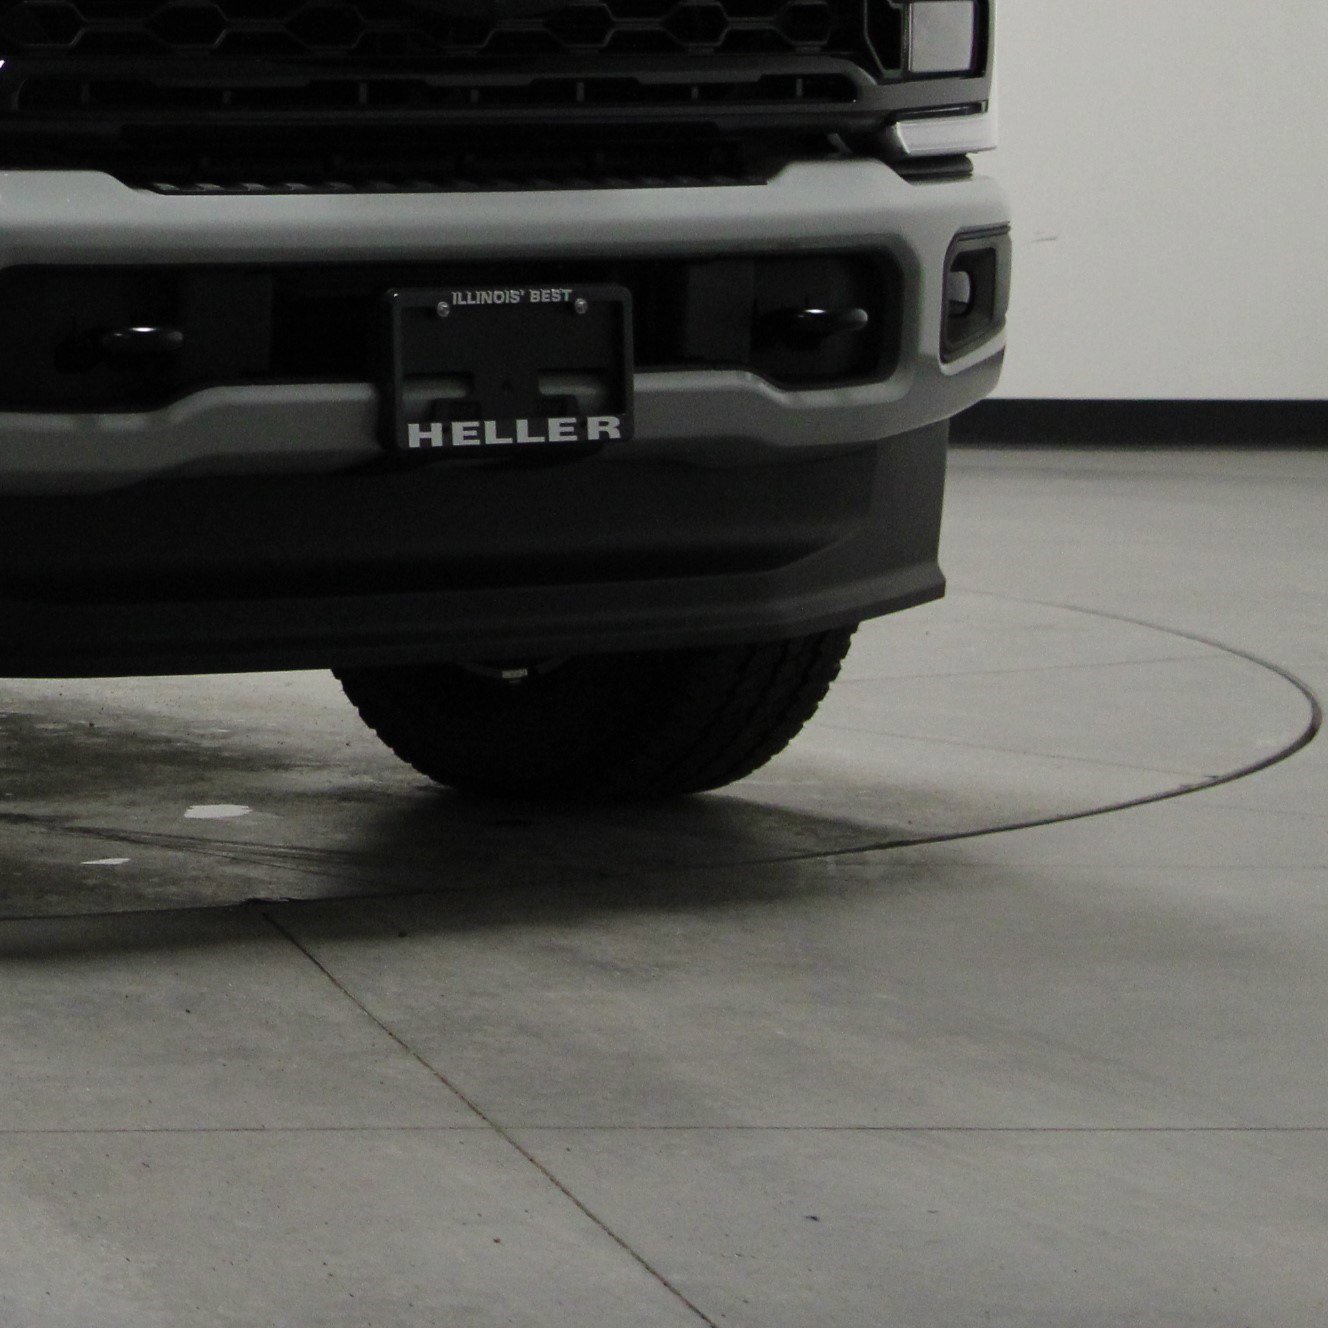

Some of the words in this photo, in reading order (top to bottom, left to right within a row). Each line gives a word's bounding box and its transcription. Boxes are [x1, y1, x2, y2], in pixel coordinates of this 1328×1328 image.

[451, 289, 525, 305] ILLINOIS'
[529, 288, 573, 303] BEST
[407, 415, 622, 448] HELLER
